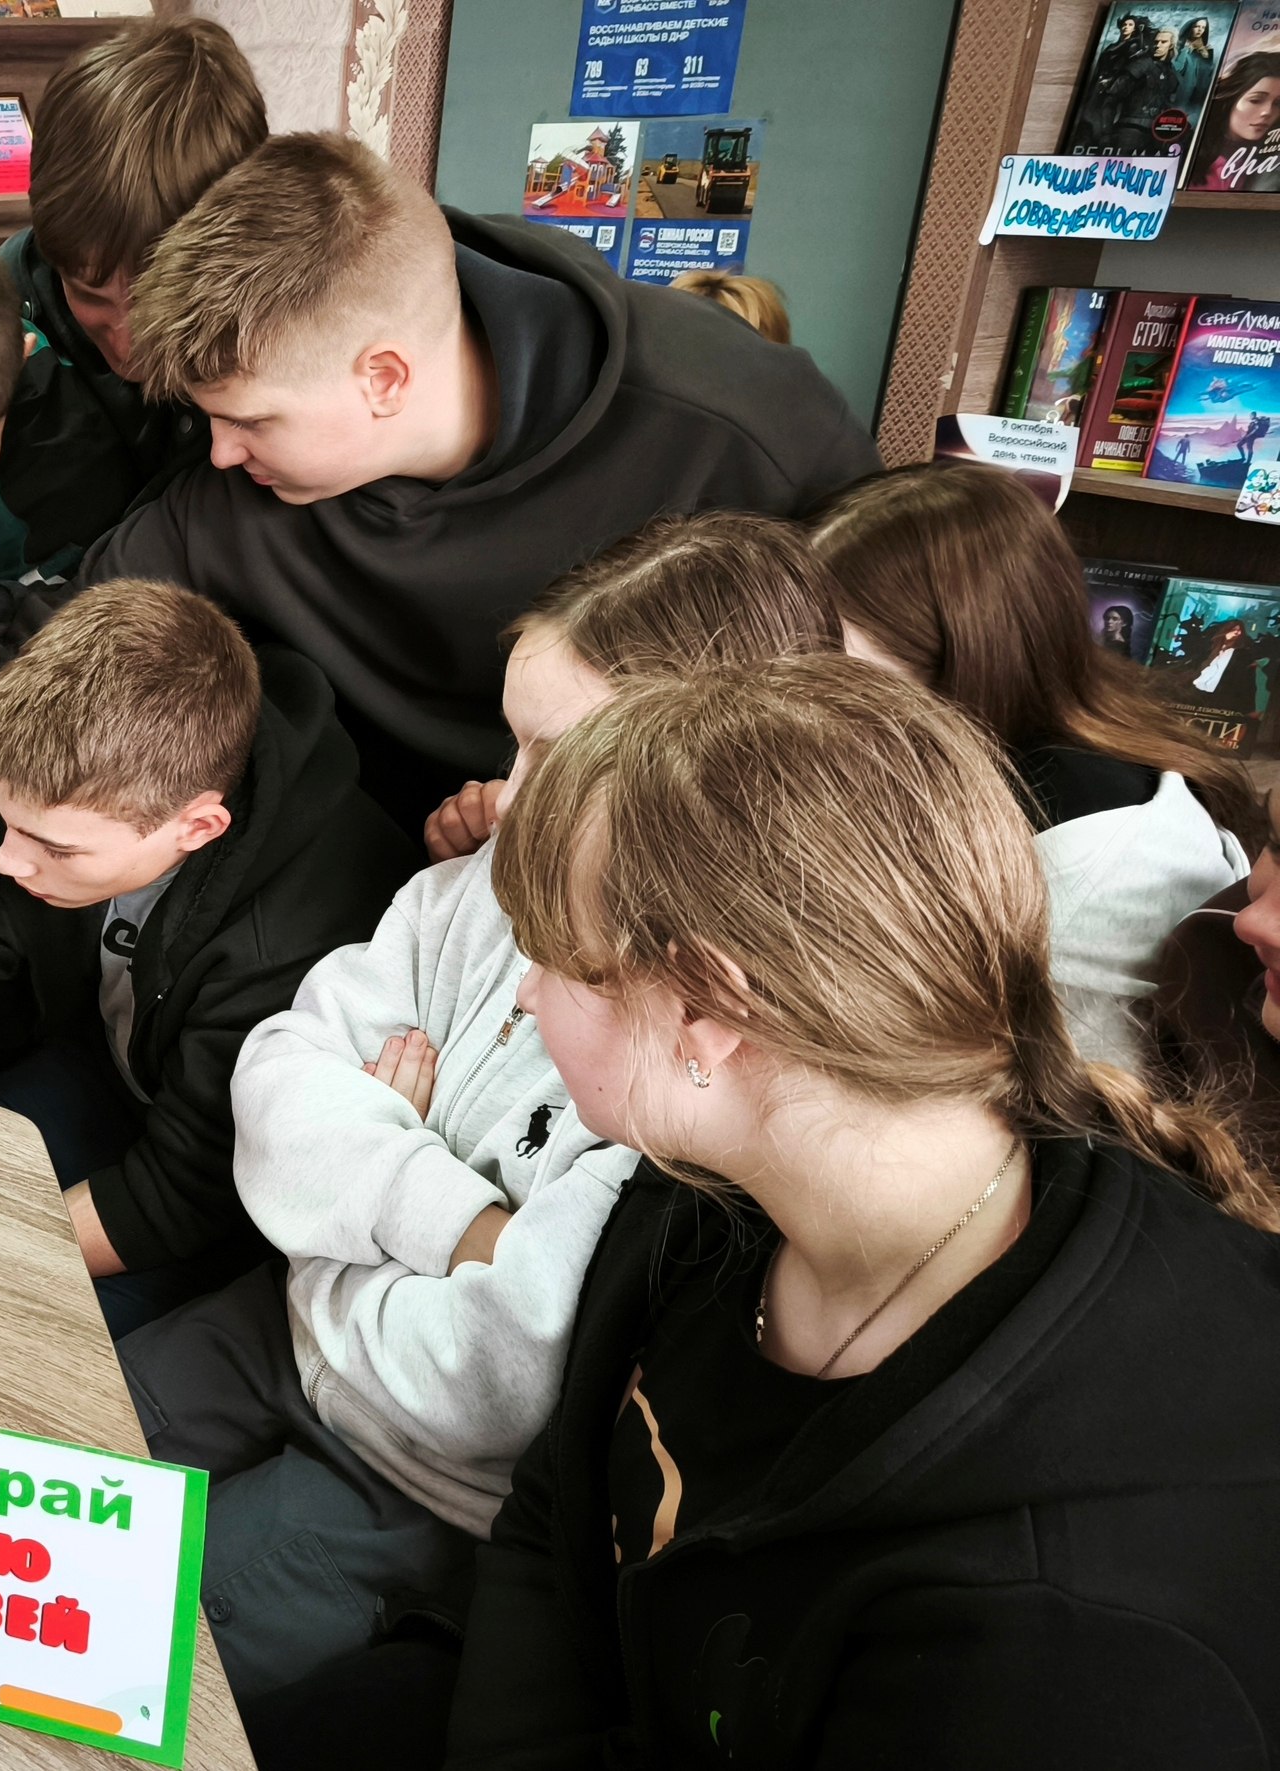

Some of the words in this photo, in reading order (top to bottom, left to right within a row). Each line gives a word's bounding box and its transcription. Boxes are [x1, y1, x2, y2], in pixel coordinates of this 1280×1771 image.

[589, 19, 682, 36] ВОССТАНАВЛИВАЕМ
[683, 16, 729, 31] ДЕТСКИЕ
[588, 35, 615, 46] САДЫ
[623, 32, 660, 44] ШКОЛЫ
[668, 31, 690, 42] ДНР
[584, 60, 603, 79] 789
[684, 56, 704, 74] 311
[1019, 158, 1099, 195] ЛУЧШИЕ
[1100, 159, 1168, 198] КНИГИ
[1003, 198, 1164, 239] СОВРЕМЕННОСТИ
[632, 268, 664, 277] ДОРОГИ
[634, 259, 714, 269] ВОССТАНАВЛИВАЕМ
[1132, 321, 1180, 348] СТРУГА
[1212, 350, 1274, 368] ИЛЛЮЗИЙ
[1002, 420, 1008, 429] 9
[1010, 423, 1054, 434] октября
[988, 433, 1068, 451] Всероссийский
[1093, 440, 1140, 458] НАЧИНАЕТСЯ
[992, 449, 1018, 460] день
[1020, 452, 1057, 465] чтения
